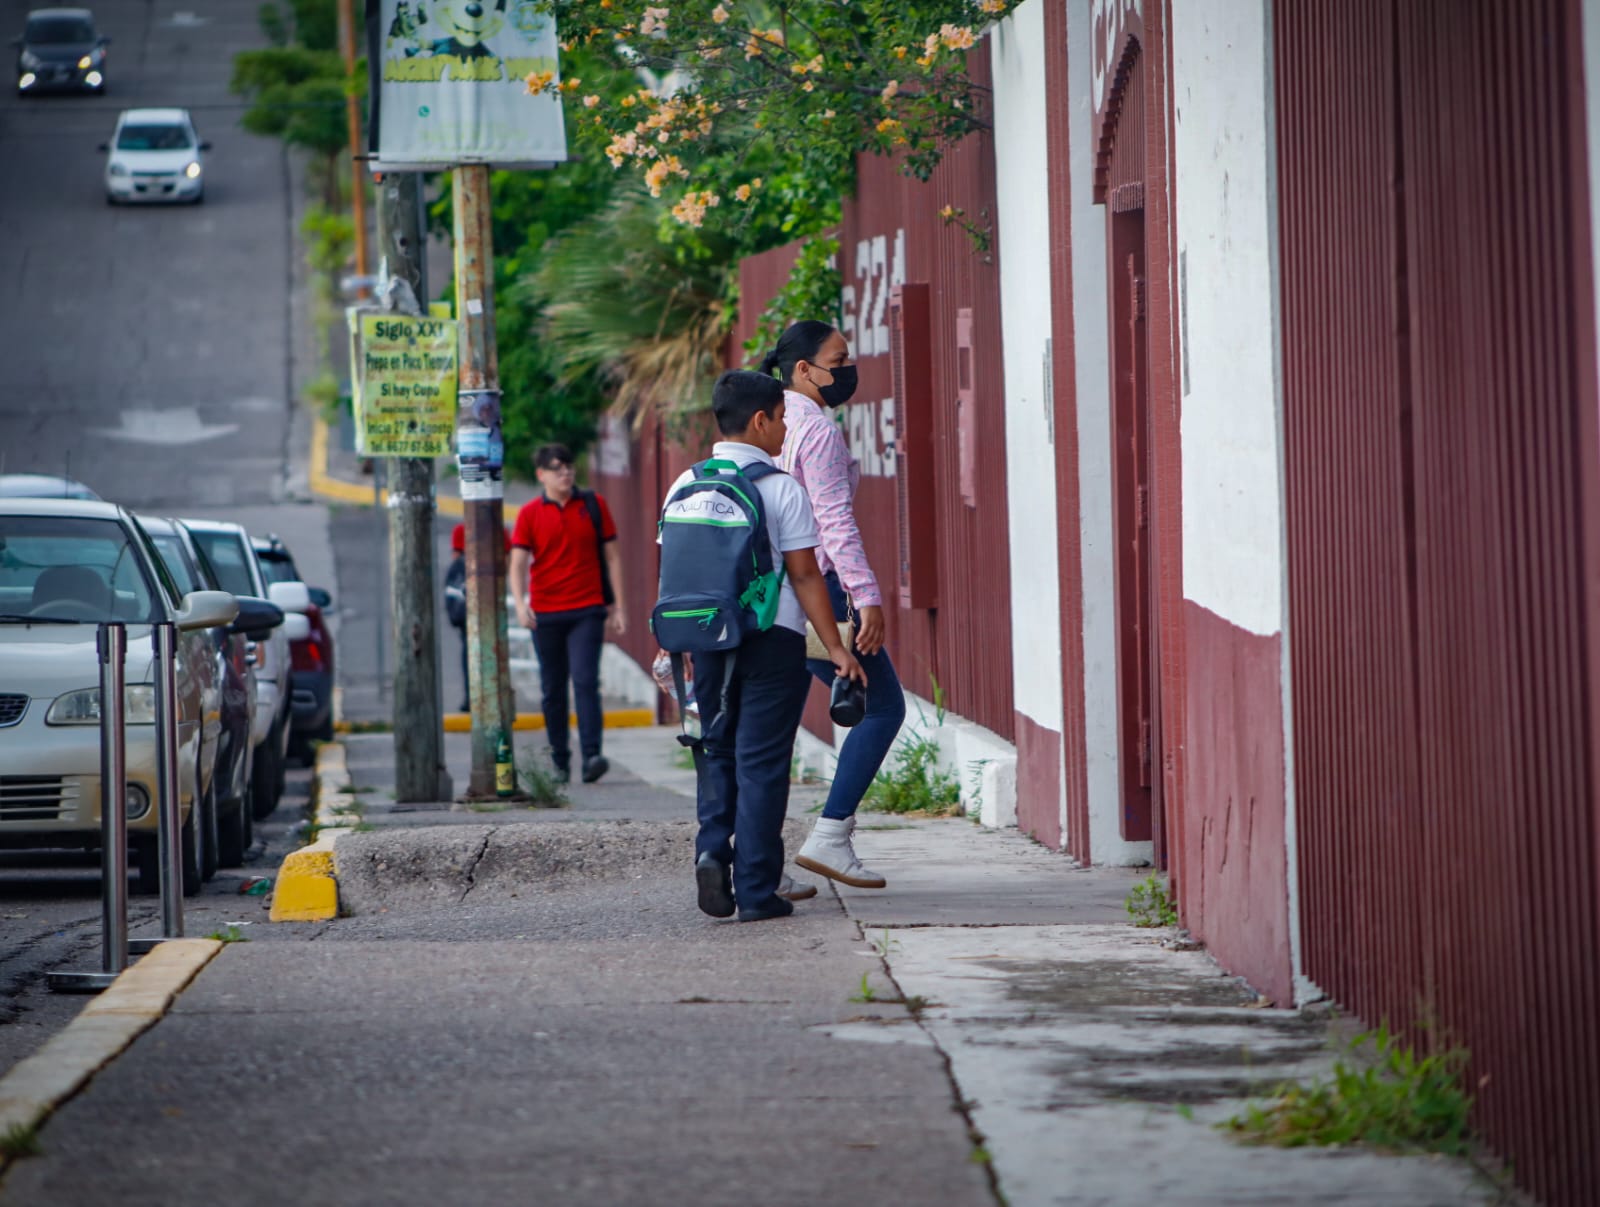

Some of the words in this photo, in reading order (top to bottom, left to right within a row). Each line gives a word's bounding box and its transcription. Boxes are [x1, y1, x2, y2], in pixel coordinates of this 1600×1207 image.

[375, 320, 412, 341] Siglo
[366, 352, 389, 372] Prepa
[390, 357, 400, 369] en
[402, 352, 422, 369] Poco
[381, 383, 391, 396] Si
[393, 383, 411, 400] hay
[413, 383, 440, 399] Cupo
[676, 500, 735, 516] NAUTICA
